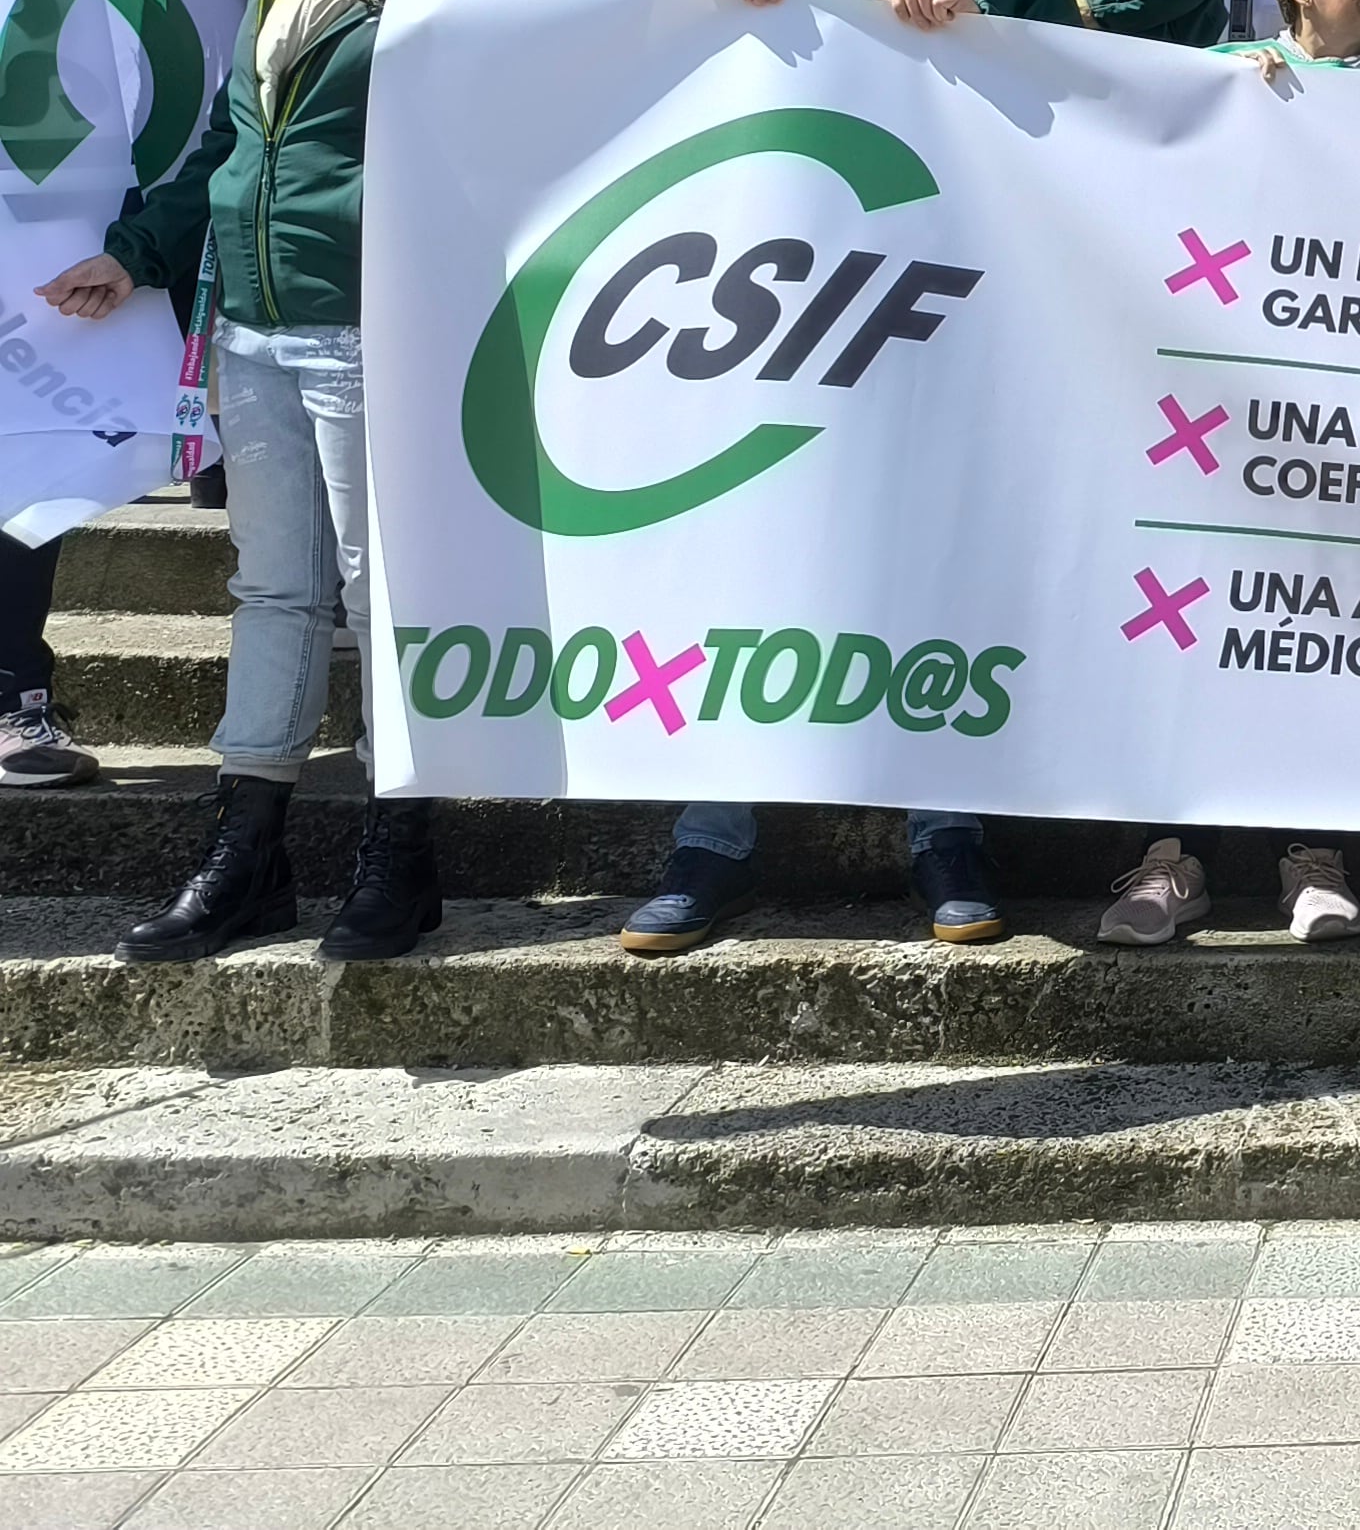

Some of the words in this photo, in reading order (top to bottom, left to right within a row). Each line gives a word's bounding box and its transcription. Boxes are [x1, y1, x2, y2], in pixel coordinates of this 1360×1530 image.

[1270, 235, 1344, 279] UN
[568, 230, 985, 388] CSIF
[1248, 399, 1357, 448] UNA
[1229, 570, 1341, 618] UNA
